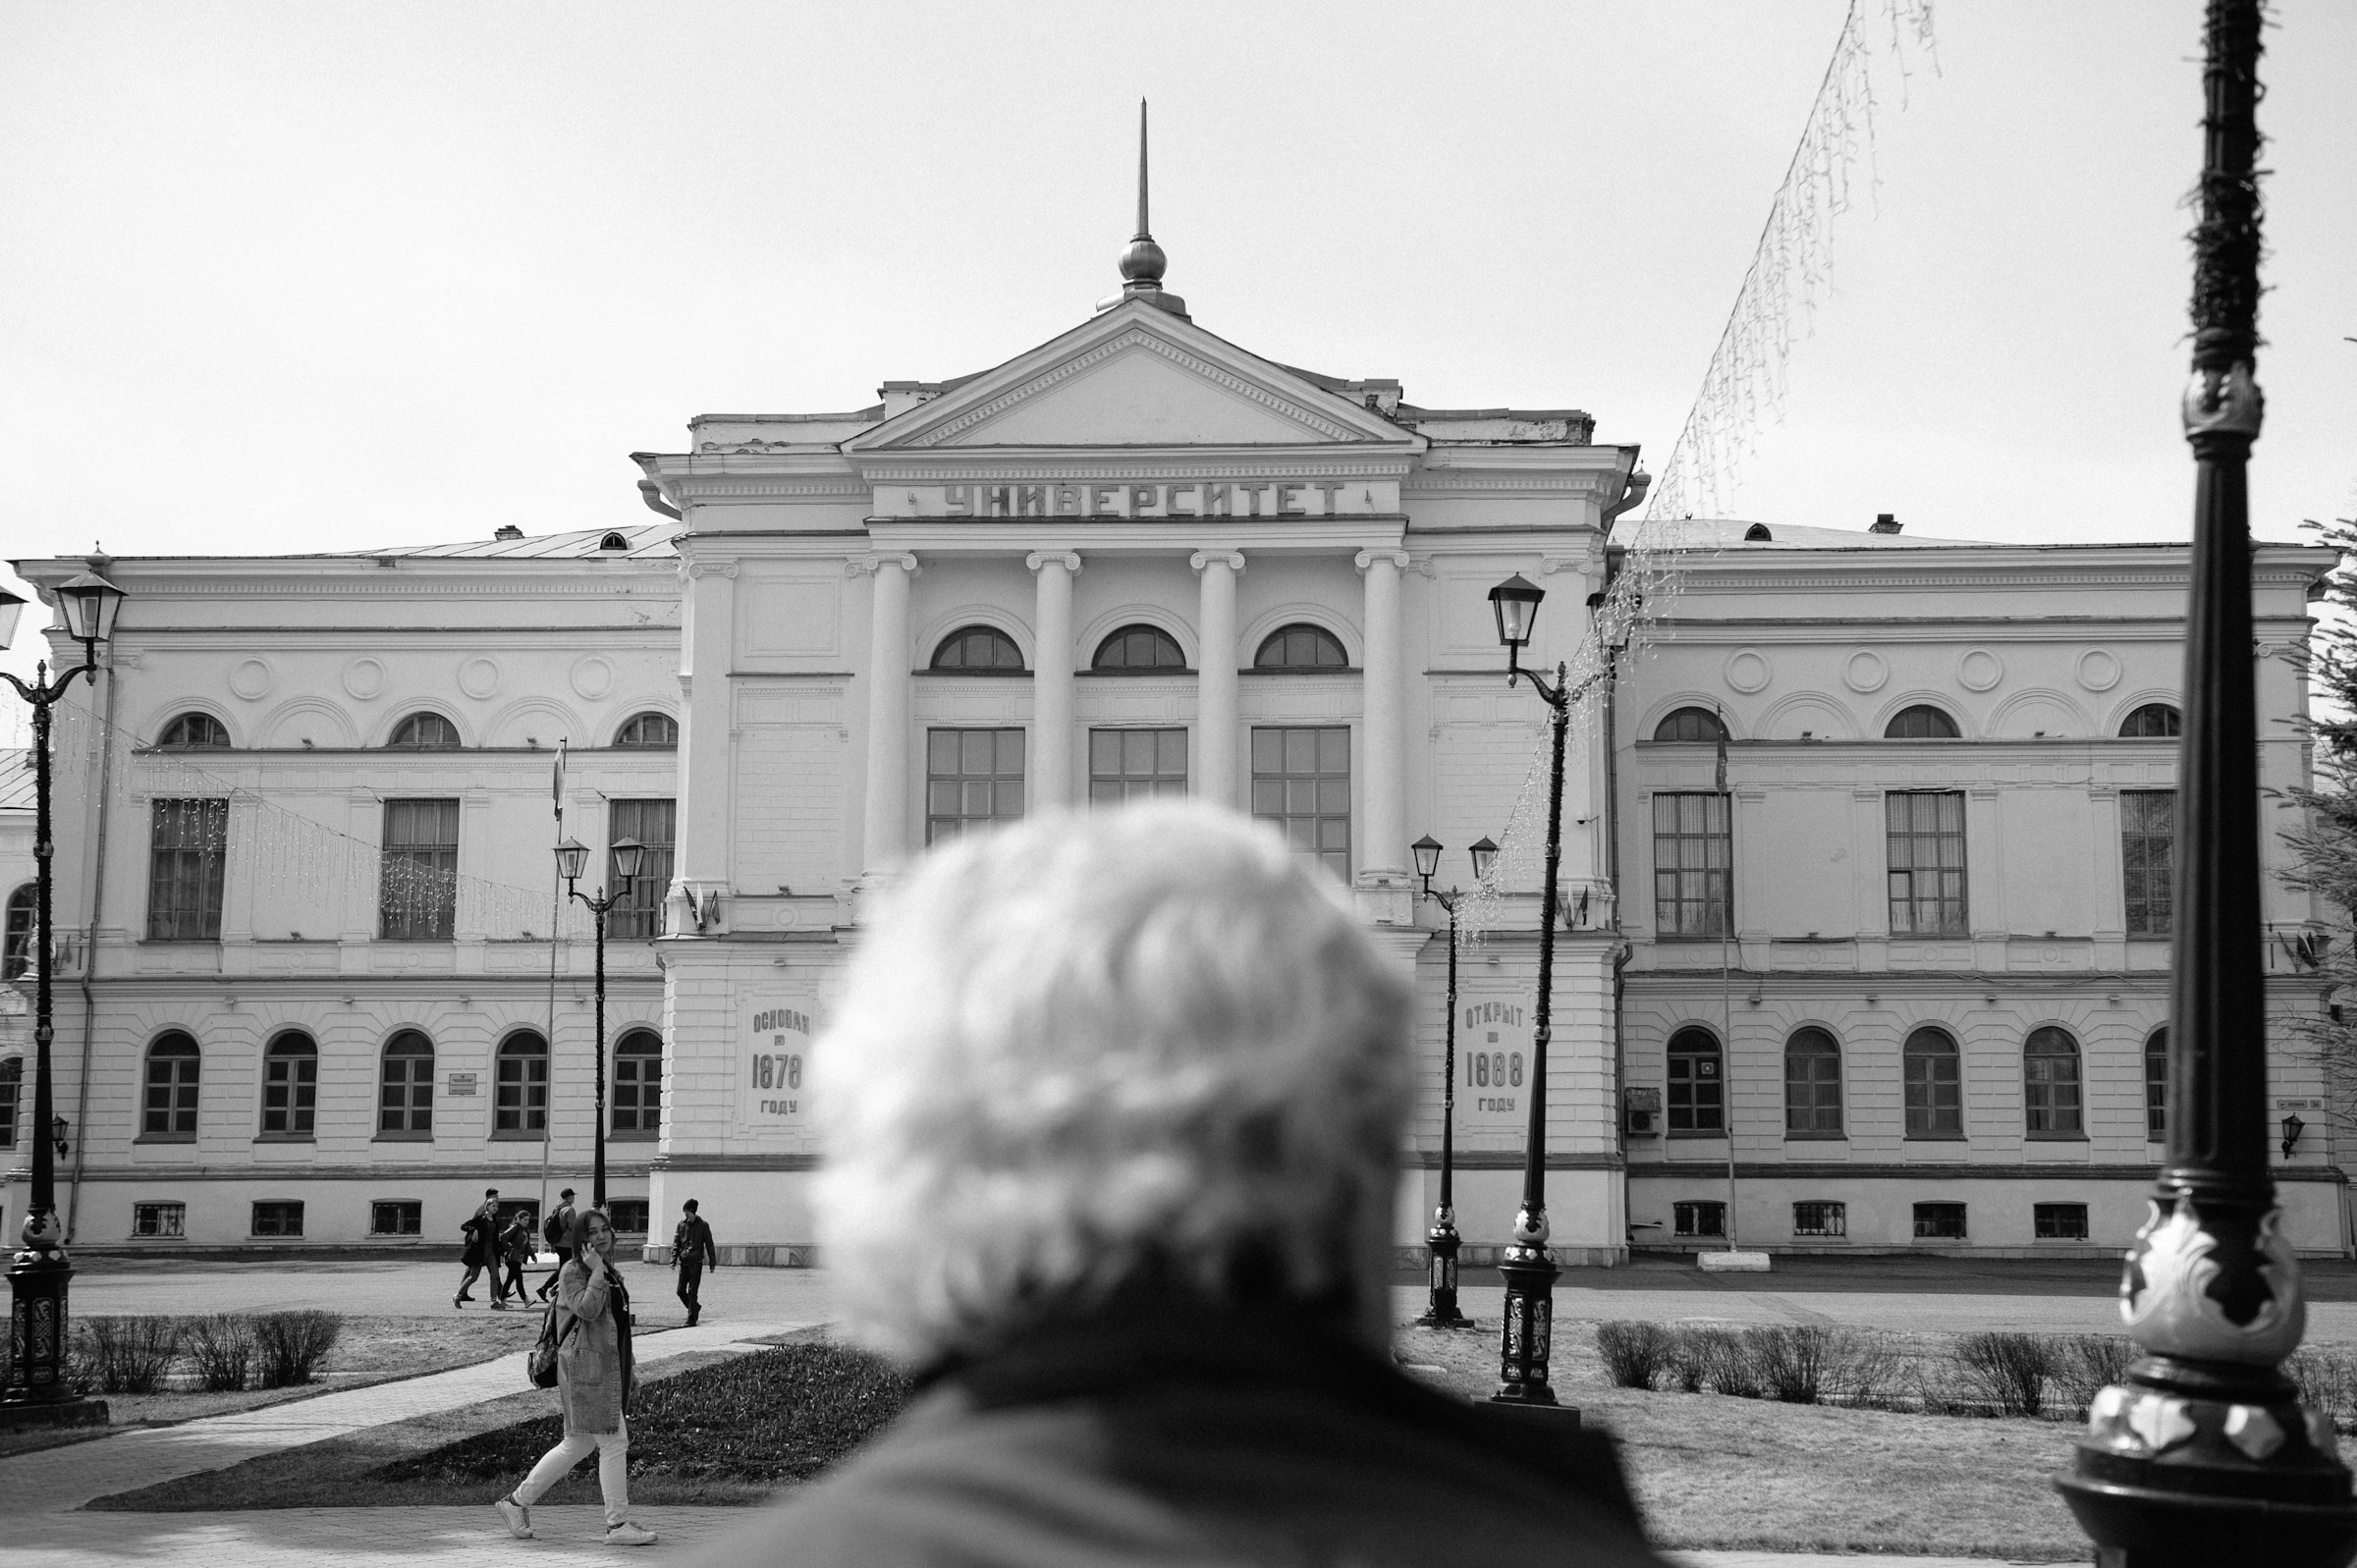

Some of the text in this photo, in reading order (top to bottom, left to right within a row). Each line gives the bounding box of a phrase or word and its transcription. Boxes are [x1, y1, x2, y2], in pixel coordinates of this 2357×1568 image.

[946, 483, 1344, 516] УНИВЕРСИТЕТ
[753, 1008, 810, 1036] ОСНОВАН
[1465, 1001, 1523, 1029] ОТКРЫТ
[774, 1035, 786, 1046] В
[752, 1054, 803, 1089] 1878
[1467, 1052, 1523, 1087] 1888
[760, 1100, 797, 1115] ГОДУ
[1478, 1098, 1515, 1112] ГОДУ
